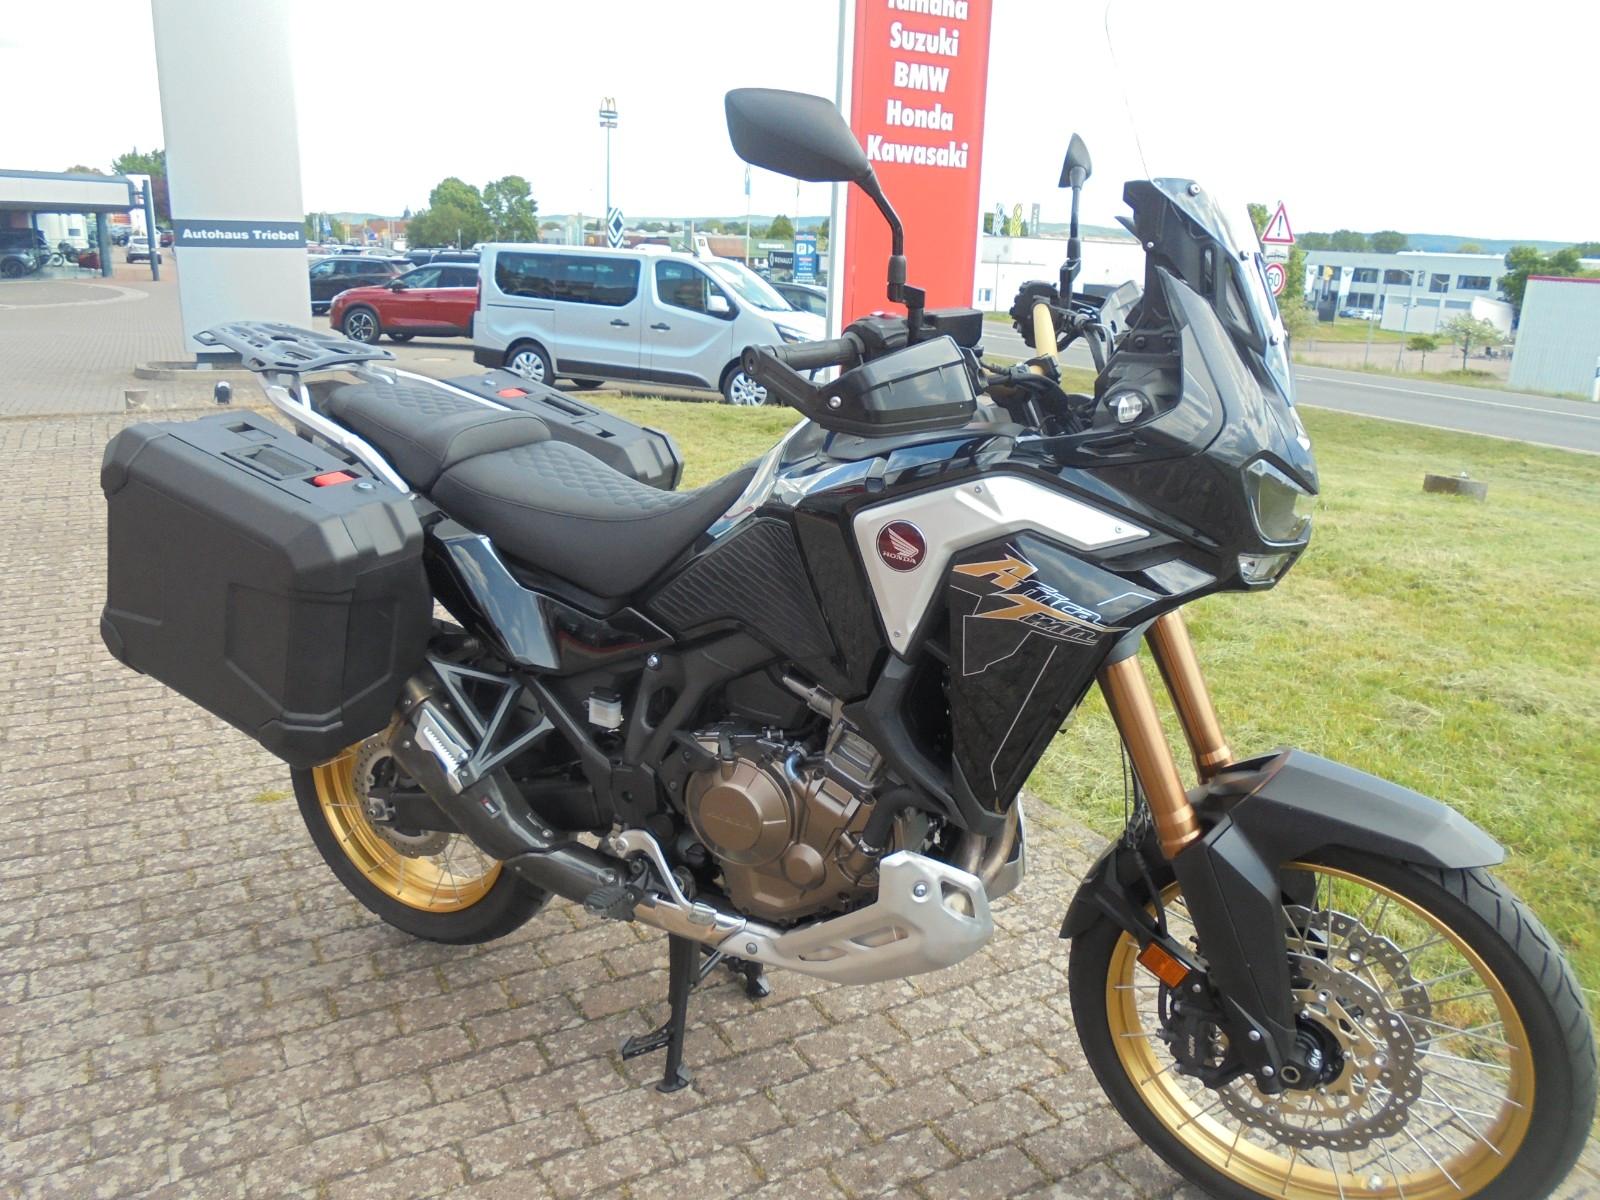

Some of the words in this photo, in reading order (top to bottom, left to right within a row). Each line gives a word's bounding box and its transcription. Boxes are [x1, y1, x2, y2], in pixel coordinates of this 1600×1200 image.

[890, 22, 959, 56] Suzuki
[894, 61, 949, 93] BMW
[886, 99, 954, 131] Honda
[866, 134, 969, 168] Kawasaki
[182, 228, 250, 240] Autohaus
[251, 229, 300, 241] Triebel
[1268, 272, 1280, 287] 50
[882, 551, 917, 564] HONDA
